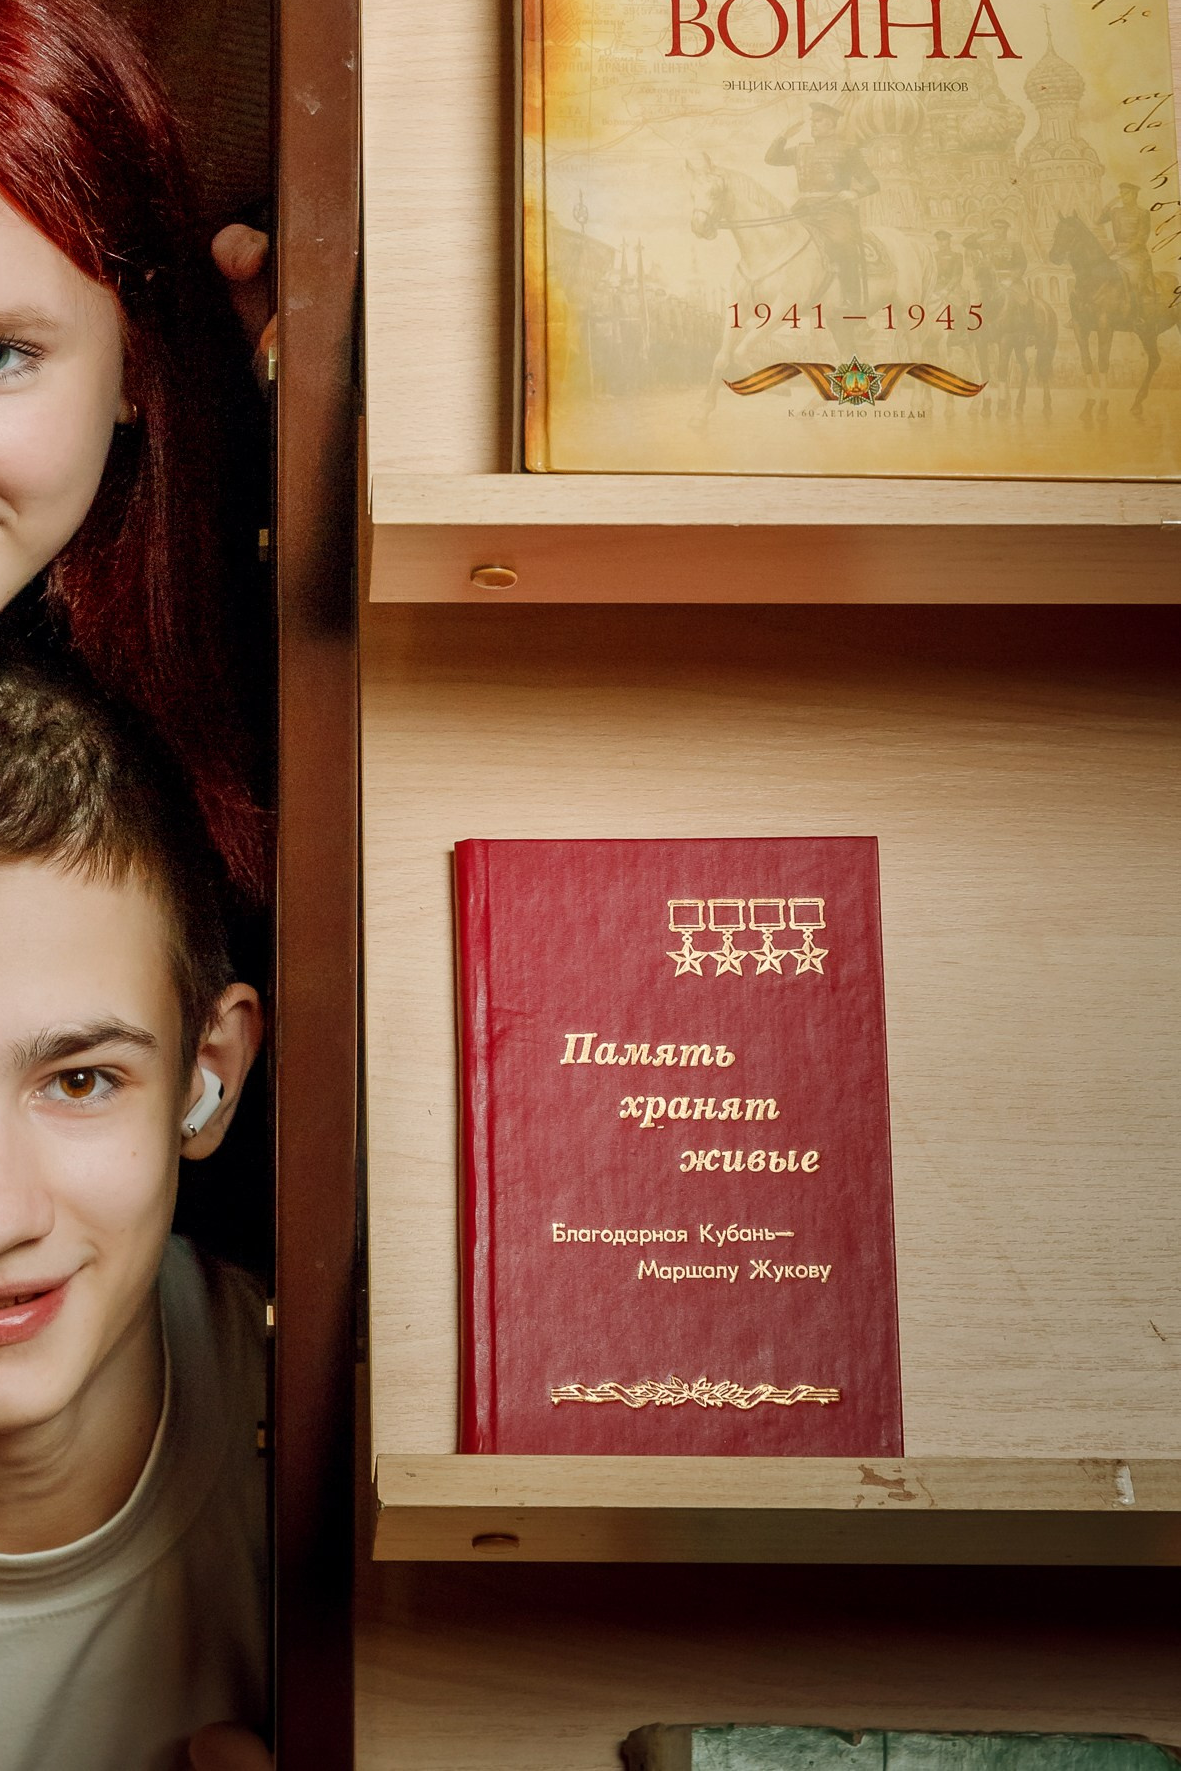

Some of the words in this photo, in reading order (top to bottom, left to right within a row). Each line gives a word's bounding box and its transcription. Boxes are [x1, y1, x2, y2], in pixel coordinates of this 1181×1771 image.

[722, 80, 838, 93] ЭНЦИКЛОПЕДИЯ
[841, 81, 869, 93] ДЛЯ
[872, 81, 969, 93] ШКОЛЬНИКОВ
[801, 409, 868, 418] 60-ЛЕТИЮ
[874, 410, 927, 419] ПОБЕДЫ
[559, 1032, 737, 1069] Память
[618, 1095, 782, 1130] хранят
[678, 1148, 822, 1174] живые
[552, 1223, 688, 1246] Благодарная
[637, 1259, 740, 1284] Маршалу
[749, 1259, 833, 1284] Жукову
